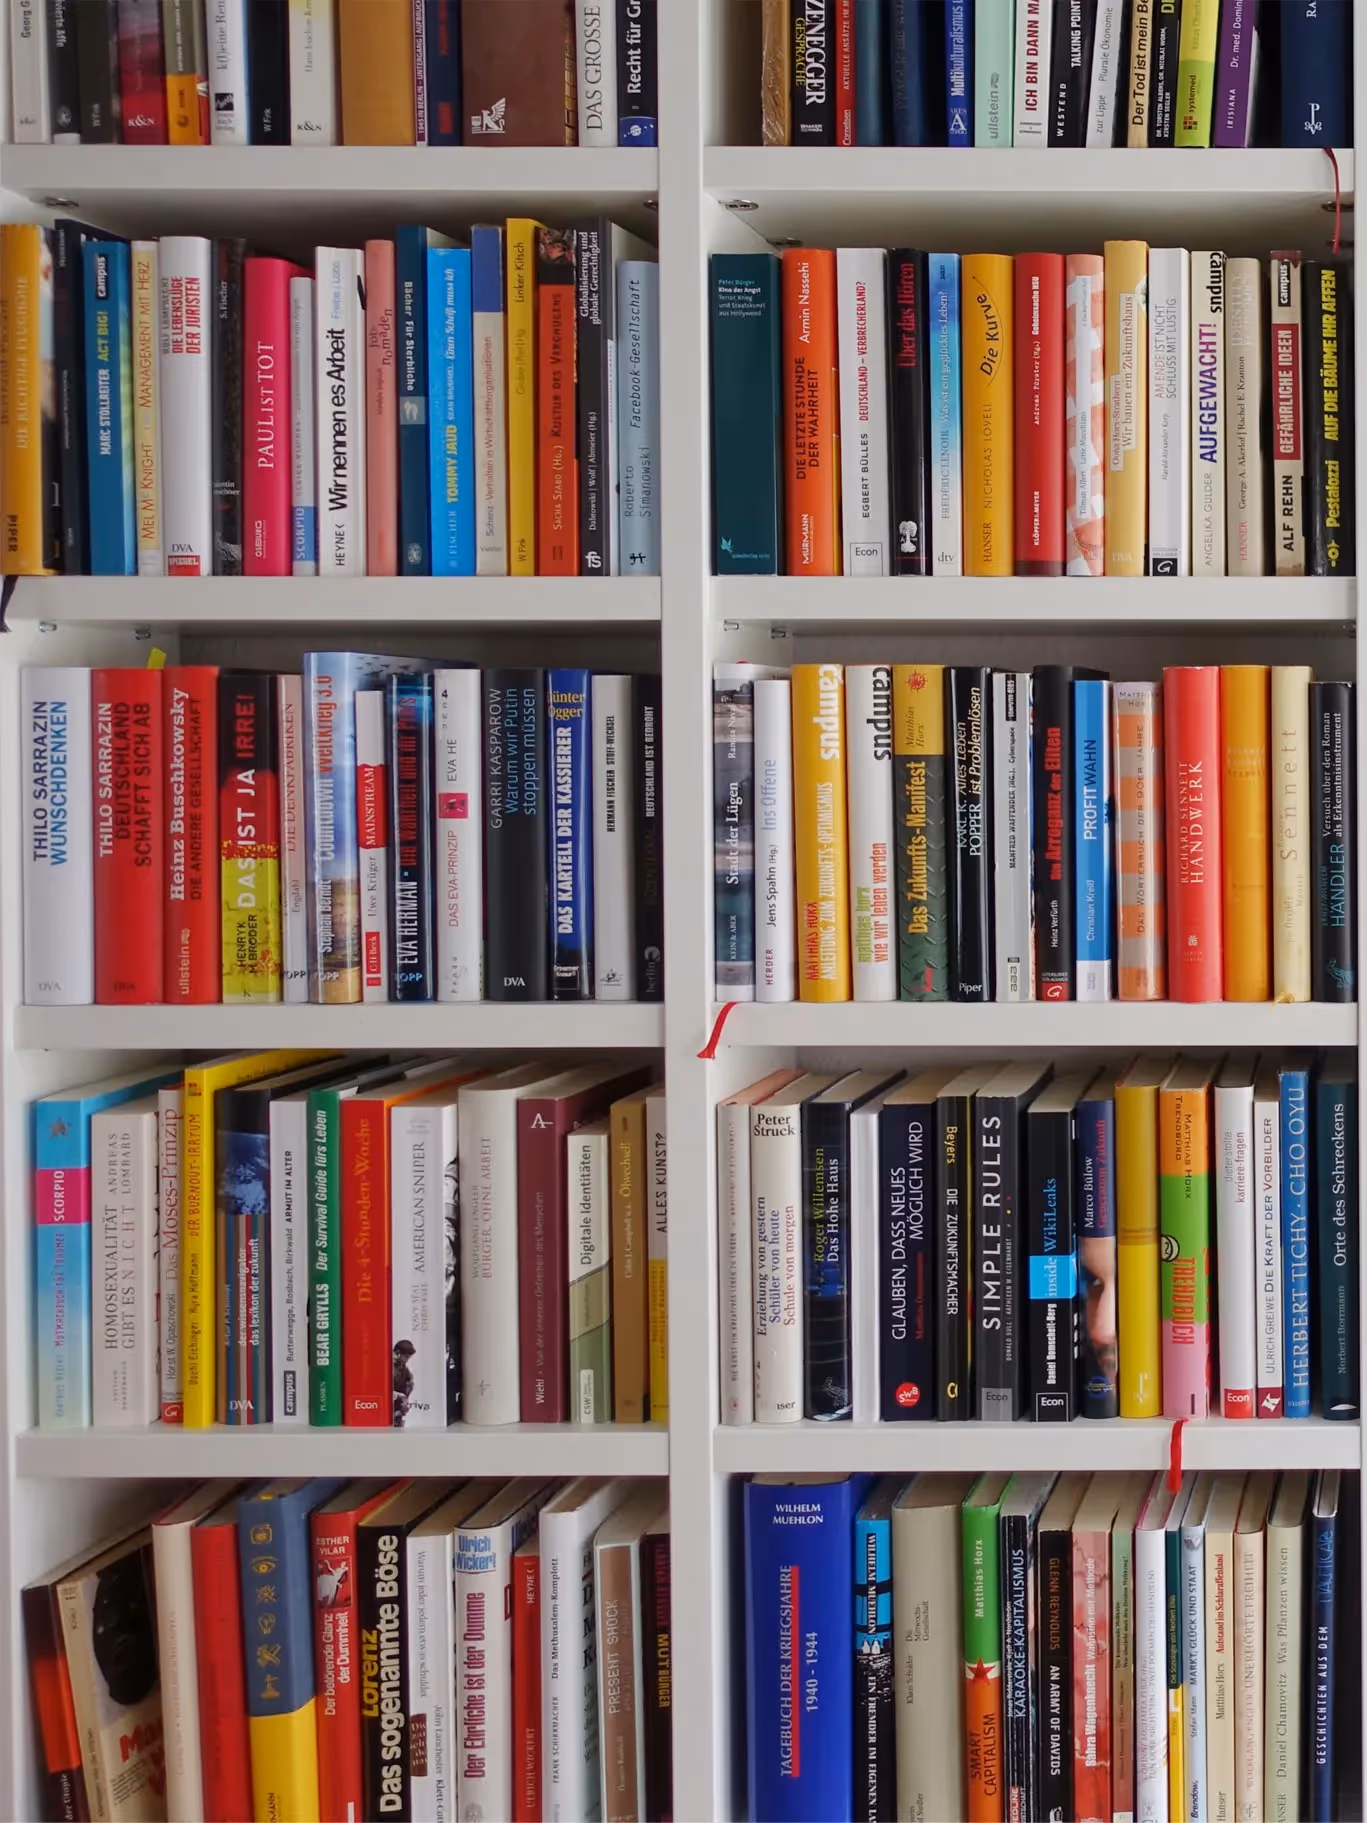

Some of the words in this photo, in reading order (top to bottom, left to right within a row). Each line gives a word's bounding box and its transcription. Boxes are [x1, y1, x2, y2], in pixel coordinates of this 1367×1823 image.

[584, 6, 602, 84] GROSSE
[585, 90, 603, 130] DAS
[988, 91, 1000, 139] ullstein
[1056, 83, 1067, 137] WESTEND
[1186, 75, 1198, 113] systemed
[579, 232, 589, 249] und
[587, 232, 601, 292] Gerechtigkeit
[96, 256, 109, 297] campus
[579, 251, 591, 317] Globalisierung
[798, 262, 811, 304] Nassehi
[97, 311, 109, 335] BIG!
[589, 295, 602, 324] globale
[798, 308, 811, 344] Armin
[975, 293, 1000, 342] Kurve
[97, 338, 109, 362] ACT
[257, 341, 274, 382] TOT
[325, 328, 346, 382] Arbeit
[628, 279, 642, 429] Facebook-Gesellschaft
[979, 348, 1000, 376] Die
[1277, 330, 1294, 366] IDEEN
[98, 368, 111, 426] STOLLREITER
[330, 385, 347, 407] es
[1198, 323, 1219, 463] AUFGEWACHT!
[1277, 370, 1295, 453] GEFÄHRLICHE
[99, 428, 112, 455] MARC
[257, 416, 275, 468] PAUL
[329, 411, 348, 478] nennen
[327, 481, 347, 511] Wir
[489, 688, 502, 775] KASPAROW
[504, 688, 518, 727] Putin
[521, 688, 536, 747] müssen
[866, 667, 891, 760] campus
[33, 701, 48, 800] SARRAZIN
[170, 688, 189, 833] Buschkowsky
[506, 731, 518, 756] wir
[51, 701, 67, 866] WUNSCHDENKEN
[364, 767, 377, 845] MAINSTREAM
[490, 781, 502, 829] GARRI
[505, 760, 519, 813] Warum
[523, 752, 539, 815] stoppen
[726, 782, 743, 823] Lügen
[1083, 739, 1097, 840] PROFITWAHN
[33, 808, 48, 862] THILO
[726, 826, 739, 851] der
[905, 761, 928, 900] Zukunfts-Manifest
[969, 803, 982, 856] POPPER
[1189, 760, 1204, 884] HANDWERK
[170, 840, 186, 900] Heinz
[726, 854, 739, 884] Stadt
[1328, 844, 1345, 927] HÄNDLER
[909, 906, 927, 933] Das
[411, 1141, 425, 1195] SNIPER
[981, 1115, 1001, 1207] RULES
[1331, 1104, 1346, 1194] Schreckens
[162, 1108, 182, 1250] Moses-Prinzip
[578, 1145, 592, 1214] Identitäten
[412, 1196, 426, 1273] AMERICAN
[1043, 1178, 1058, 1252] WikiLeaks
[1333, 1200, 1346, 1226] des
[579, 1217, 593, 1265] Digitale
[1334, 1230, 1347, 1266] Orte
[102, 1204, 118, 1349] HOMOSEXUALITÄT
[166, 1254, 179, 1281] Das
[982, 1224, 1001, 1330] SIMPLE
[315, 1283, 330, 1329] GRYLLS
[315, 1332, 330, 1366] BEAR
[773, 1515, 824, 1524] MUEHLON
[776, 1503, 822, 1512] WILHELM
[375, 1535, 399, 1598] Böse
[463, 1592, 485, 1641] Dumme
[779, 1565, 793, 1660] KRIEGSJAHRE
[1011, 1549, 1026, 1717] KARAOKE-KAPITALISMUS
[463, 1646, 485, 1669] der
[806, 1631, 818, 1665] 1944
[378, 1604, 405, 1760] sogenannte
[463, 1674, 484, 1690] ist
[780, 1665, 792, 1692] DER
[806, 1678, 819, 1713] 1940
[463, 1695, 486, 1749] Ehrliche
[780, 1697, 793, 1777] TAGEBUCH
[380, 1764, 402, 1813] Das
[463, 1754, 486, 1779] Der
